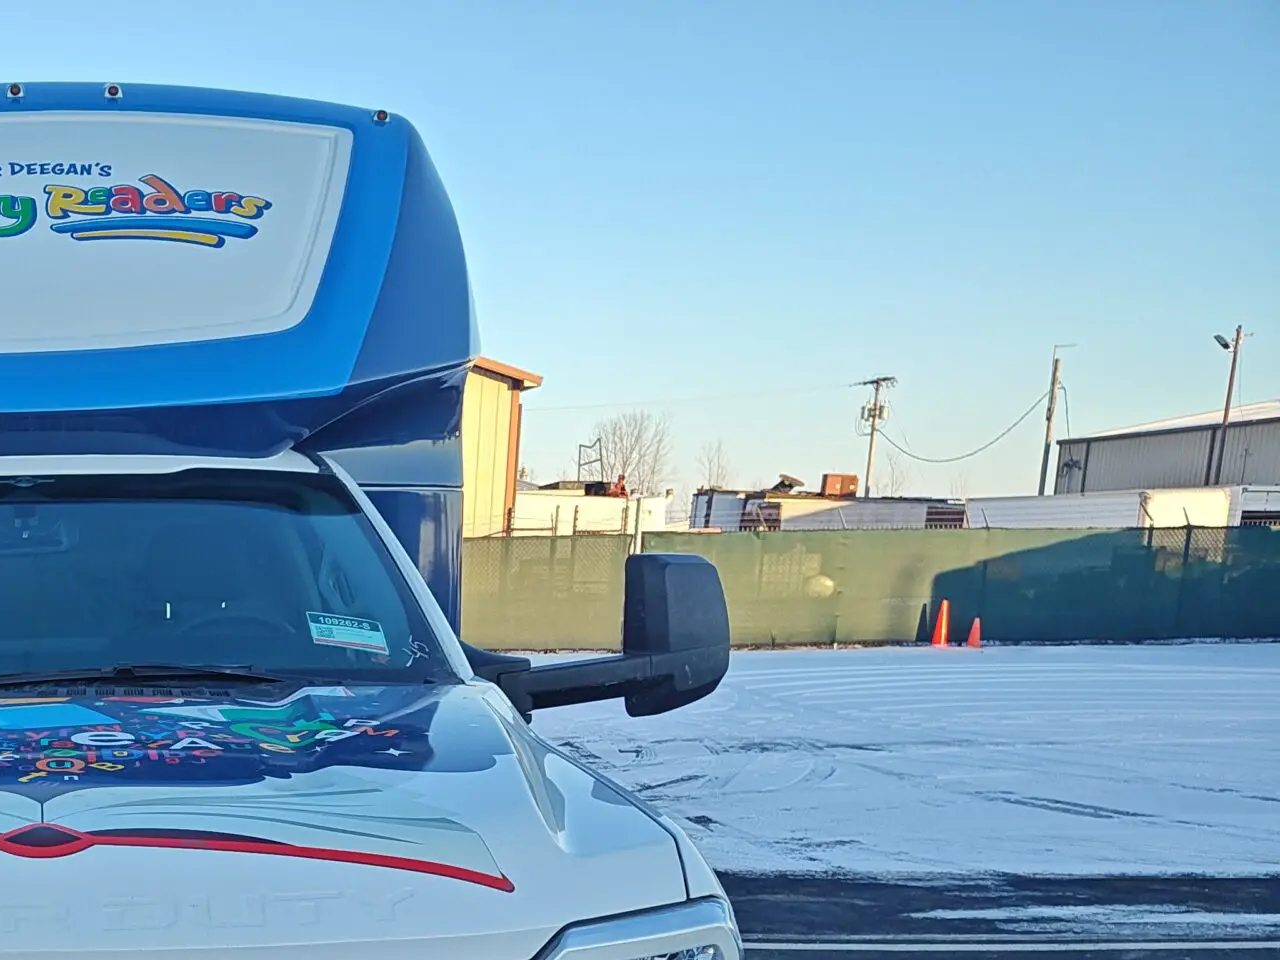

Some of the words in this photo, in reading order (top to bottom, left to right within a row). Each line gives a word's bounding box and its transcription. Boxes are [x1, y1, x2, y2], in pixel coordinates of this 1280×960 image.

[8, 162, 112, 177] DEEGAN'S
[43, 173, 273, 220] Readers
[71, 731, 136, 746] e
[170, 738, 224, 750] A
[103, 887, 415, 931] DUTY
